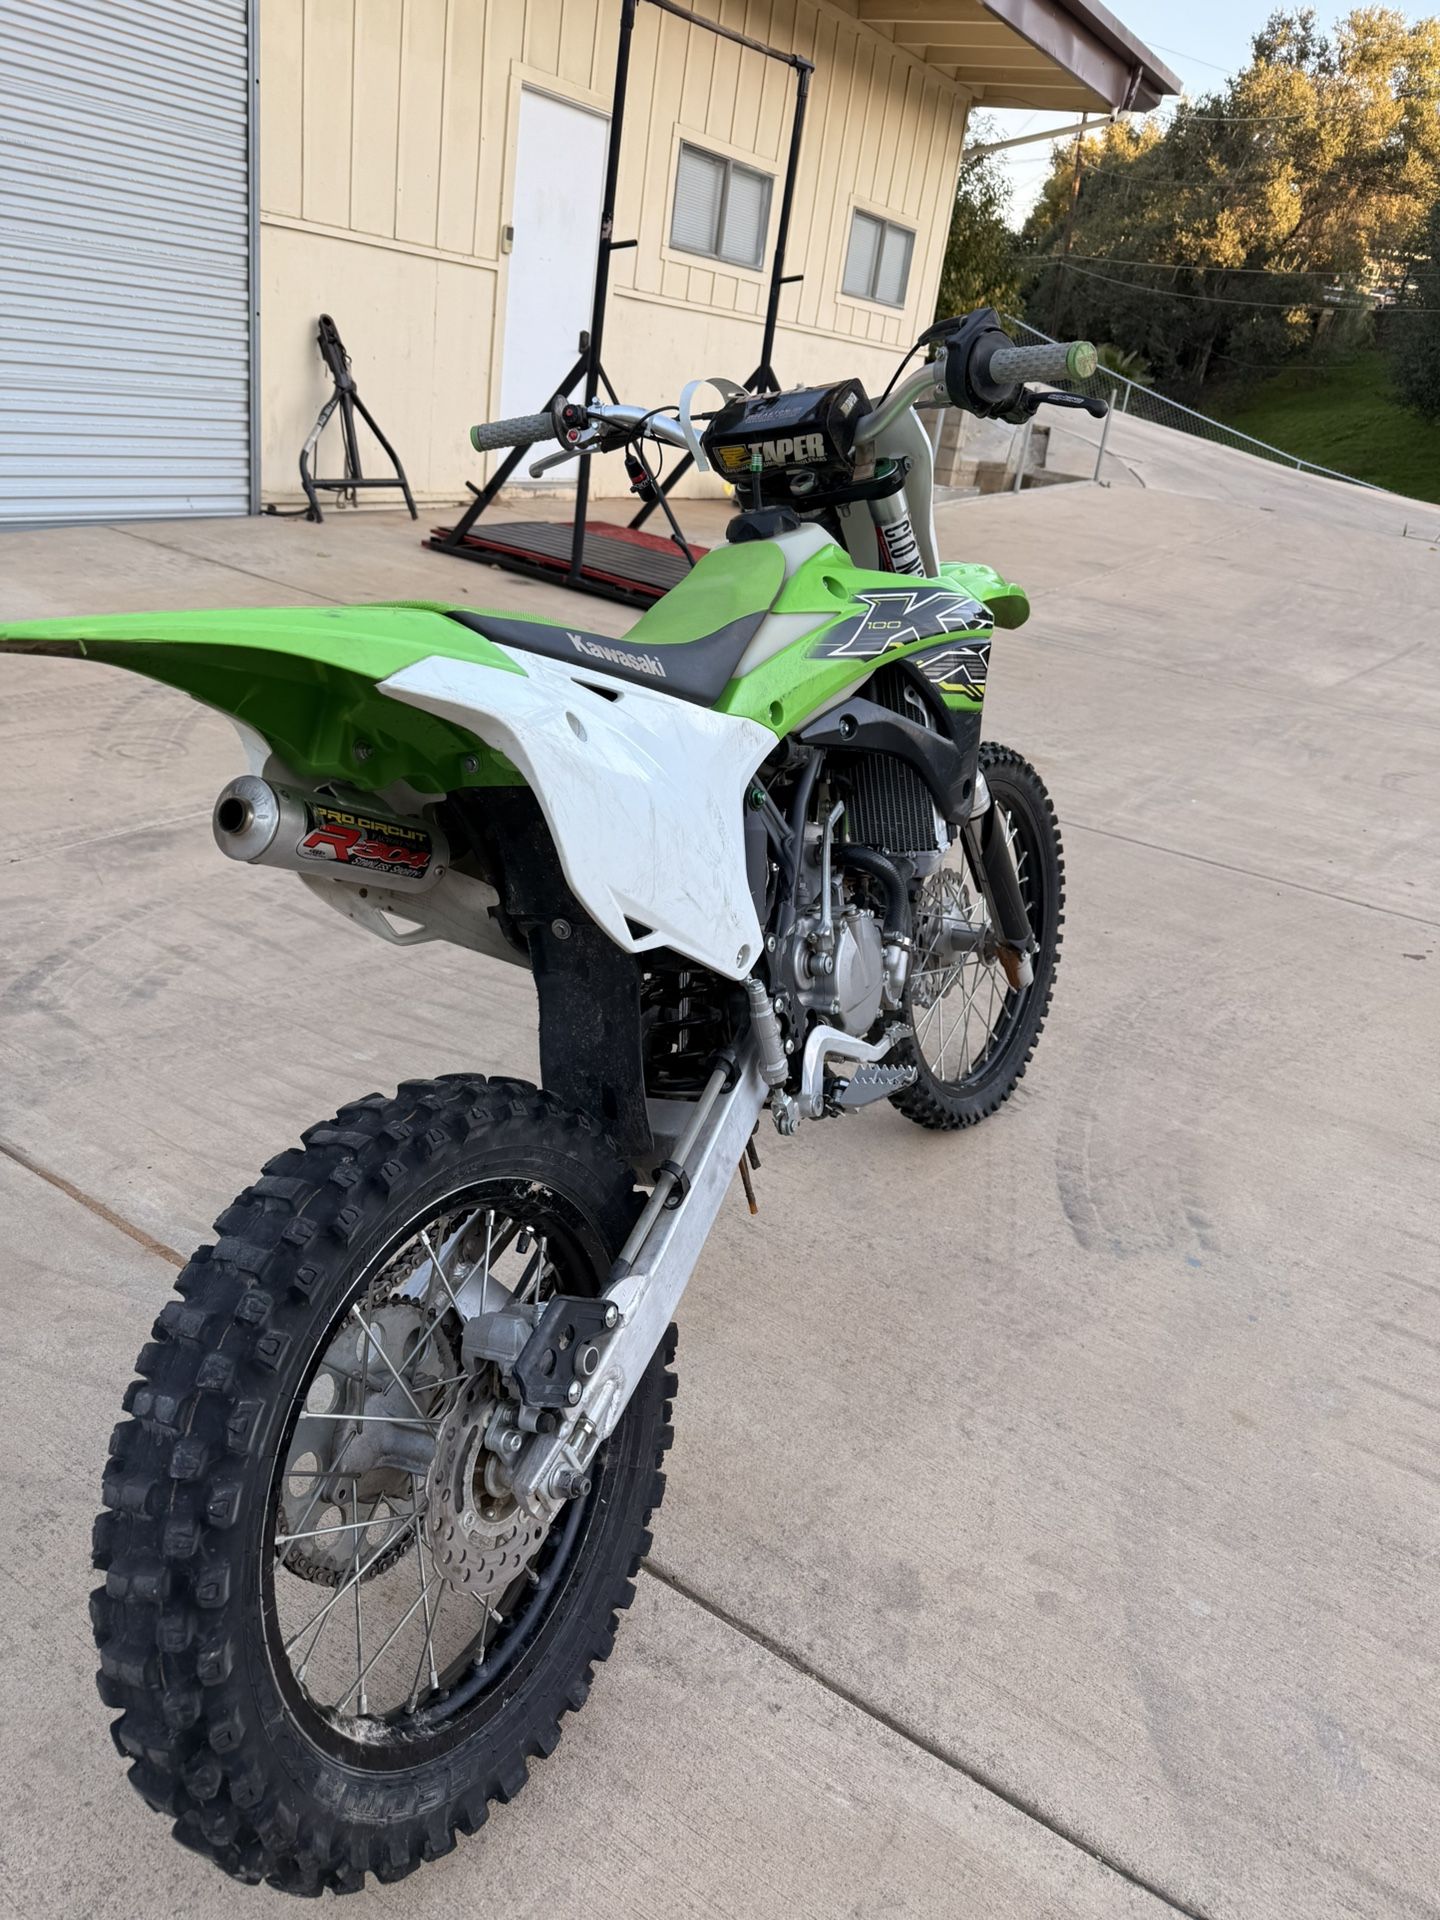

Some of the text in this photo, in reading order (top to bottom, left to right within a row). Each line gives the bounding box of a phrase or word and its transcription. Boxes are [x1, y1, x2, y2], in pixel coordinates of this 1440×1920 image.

[748, 433, 825, 467] TAPER
[867, 620, 902, 630] 100
[566, 632, 667, 678] Kawasaki
[314, 807, 355, 824] PRO
[357, 818, 428, 843] CIRCUIT
